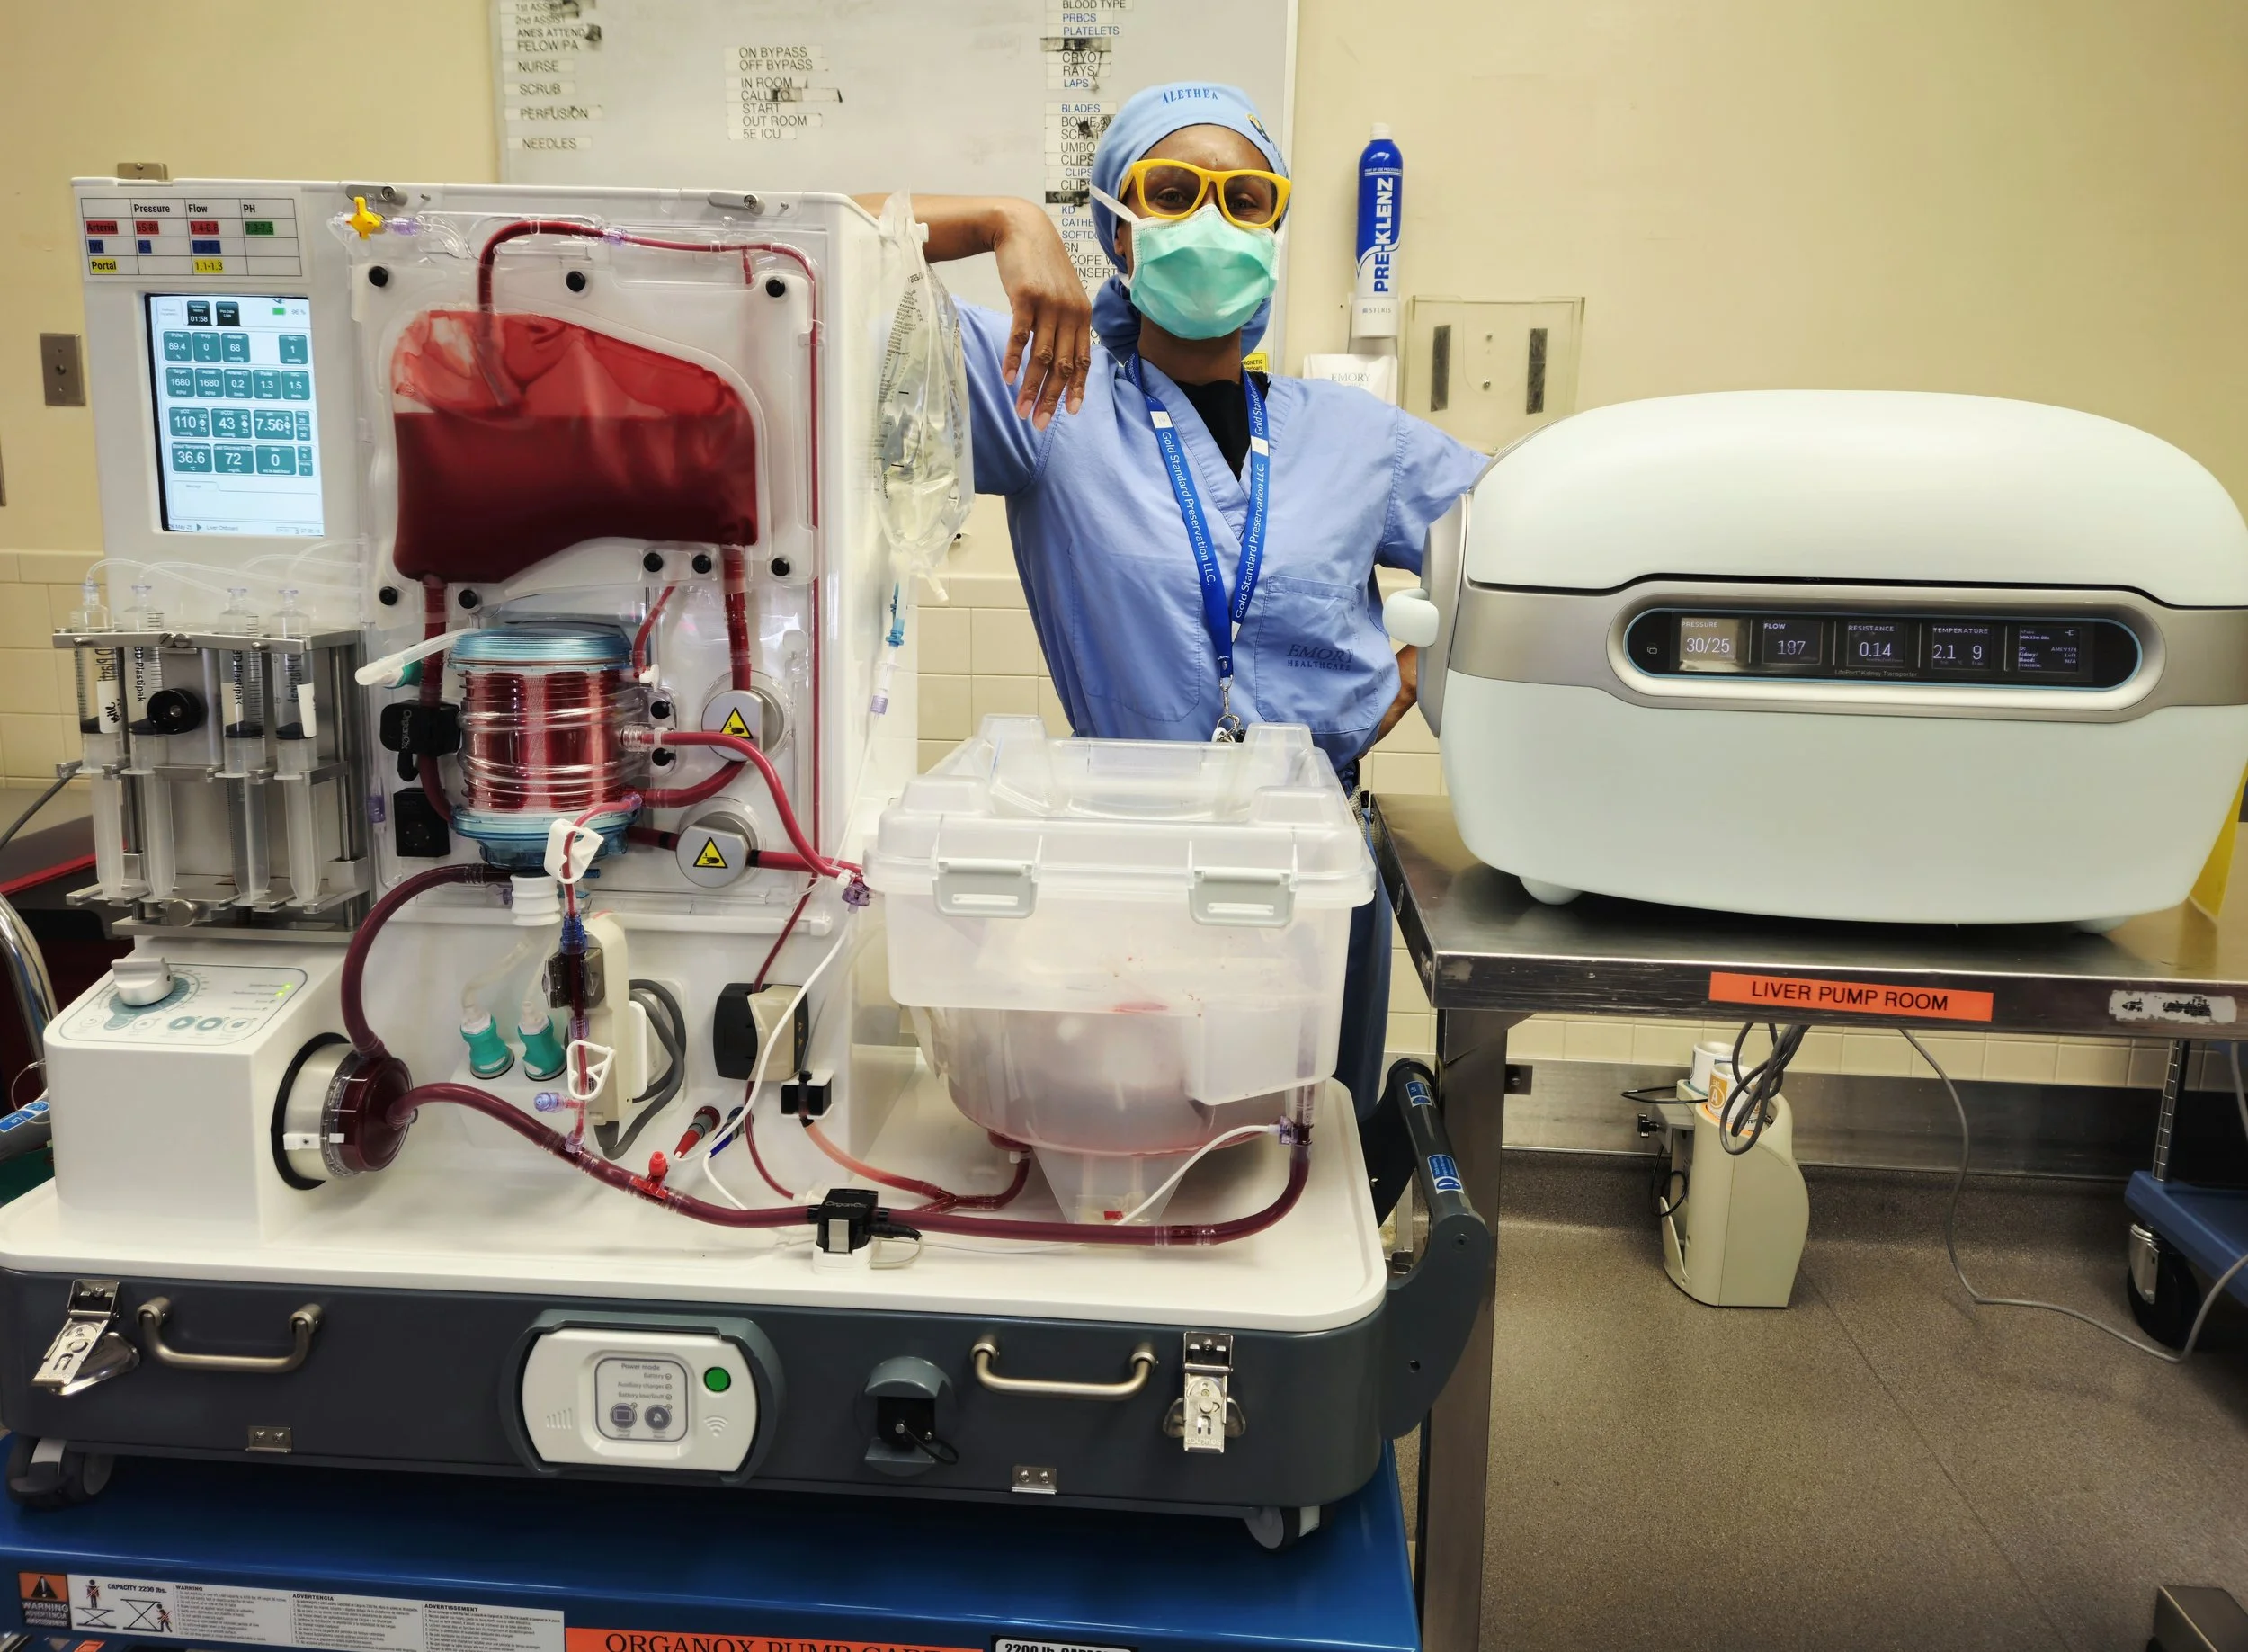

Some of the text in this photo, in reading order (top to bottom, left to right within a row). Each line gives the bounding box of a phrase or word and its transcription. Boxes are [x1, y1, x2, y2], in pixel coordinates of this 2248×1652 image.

[1062, 0, 1126, 9] BLOOD TYPE
[1062, 13, 1097, 22] PRBCS
[517, 27, 586, 38] ANES ATTEND
[1063, 25, 1120, 36] PLATELETS
[517, 39, 580, 52] FELOW PA
[738, 46, 807, 58] ON BYPASS
[1062, 51, 1097, 63] CRYO
[517, 59, 559, 73] NURSE
[739, 58, 813, 71] OFF BYPASS
[1063, 65, 1095, 76] RAYS
[740, 76, 793, 89] IN ROOM
[1064, 78, 1089, 88] LAPS
[519, 83, 561, 95] SCRUB
[740, 89, 771, 102] CALL
[1162, 87, 1218, 105] ALETHEA
[520, 107, 589, 121] PERFUSION
[742, 103, 781, 114] START
[1062, 103, 1101, 113] BLADES
[742, 115, 807, 127] OUT ROOM
[743, 128, 781, 139] 5E ICU
[522, 138, 577, 150] NEEDLES
[1060, 141, 1095, 153] UMBO
[134, 204, 171, 213] Pressure
[188, 204, 208, 213] Flow
[243, 204, 256, 213] PH
[1062, 205, 1075, 214] KD
[86, 221, 118, 234] Arterial
[1069, 254, 1102, 265] COPE
[91, 261, 117, 271] Portal
[194, 261, 223, 271] 1.1-1.3
[168, 342, 186, 351] 89.4
[203, 343, 210, 351] 0
[229, 344, 241, 352] 68
[290, 345, 296, 353] 1
[171, 379, 191, 387] 1680
[1331, 372, 1371, 382] EMORY
[200, 379, 219, 388] 1680
[231, 380, 245, 388] 0.2
[261, 380, 274, 389] 1.3
[290, 381, 302, 389] 1.5
[174, 415, 197, 429] 110
[219, 417, 236, 430] 43
[254, 417, 284, 432] 7.56
[1254, 417, 1264, 436] Gold
[176, 451, 206, 464] 36.6
[225, 452, 242, 465] 72
[271, 454, 280, 467] 0
[1162, 431, 1216, 585] Gold Standard Preservation LLC.
[1236, 463, 1265, 619] Gold Standard Preservation LLC.
[1848, 624, 1895, 632] RESISTANCE
[1932, 627, 1989, 635] TEMPERATURE
[1685, 637, 1731, 654] 30/25
[1777, 639, 1806, 656] 187
[1859, 641, 1893, 658] 0.14
[1932, 644, 1957, 659] 2.1
[1286, 643, 1354, 664] EMORY
[1972, 645, 1983, 660] 9
[1287, 659, 1351, 671] HEALTHCARE
[134, 662, 147, 702] Plastipak
[232, 665, 244, 705] Plastipak
[1751, 980, 1949, 1012] LIVER PUMP ROOM
[107, 1583, 137, 1591] CAPACITY
[22, 1602, 68, 1612] WARNING
[424, 1603, 478, 1612] ADVERTISSEMENT
